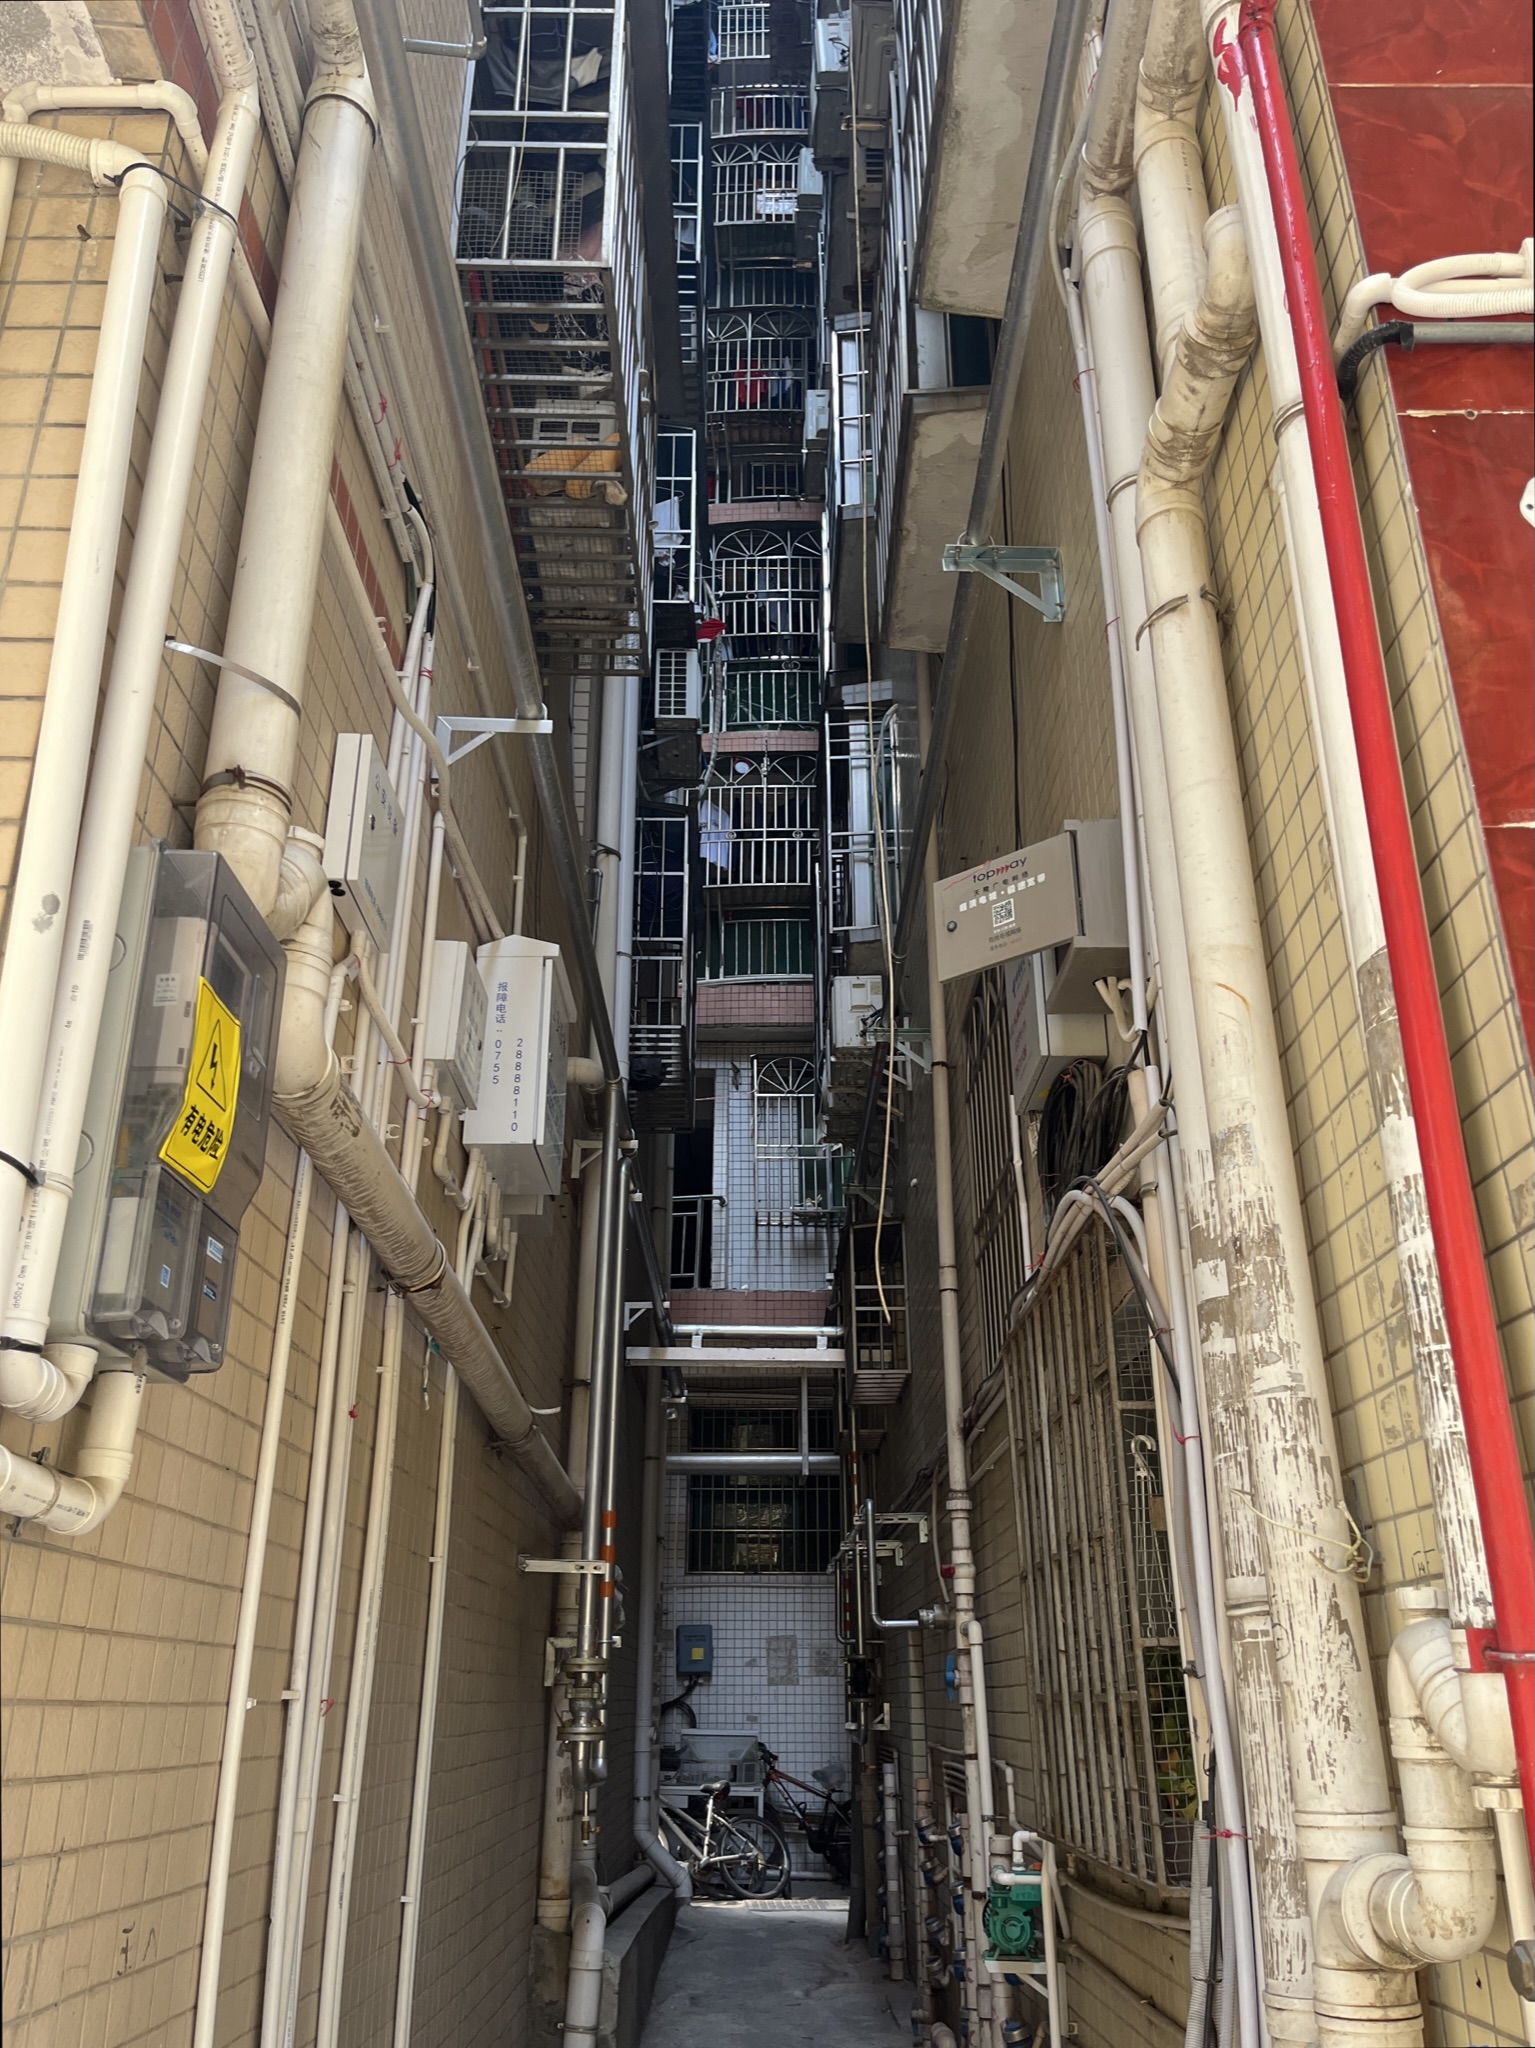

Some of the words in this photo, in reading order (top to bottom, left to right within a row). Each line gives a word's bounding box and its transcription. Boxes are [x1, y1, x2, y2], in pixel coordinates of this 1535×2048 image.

[510, 1037, 524, 1132] 28888110
[180, 1103, 224, 1160] 有电危险
